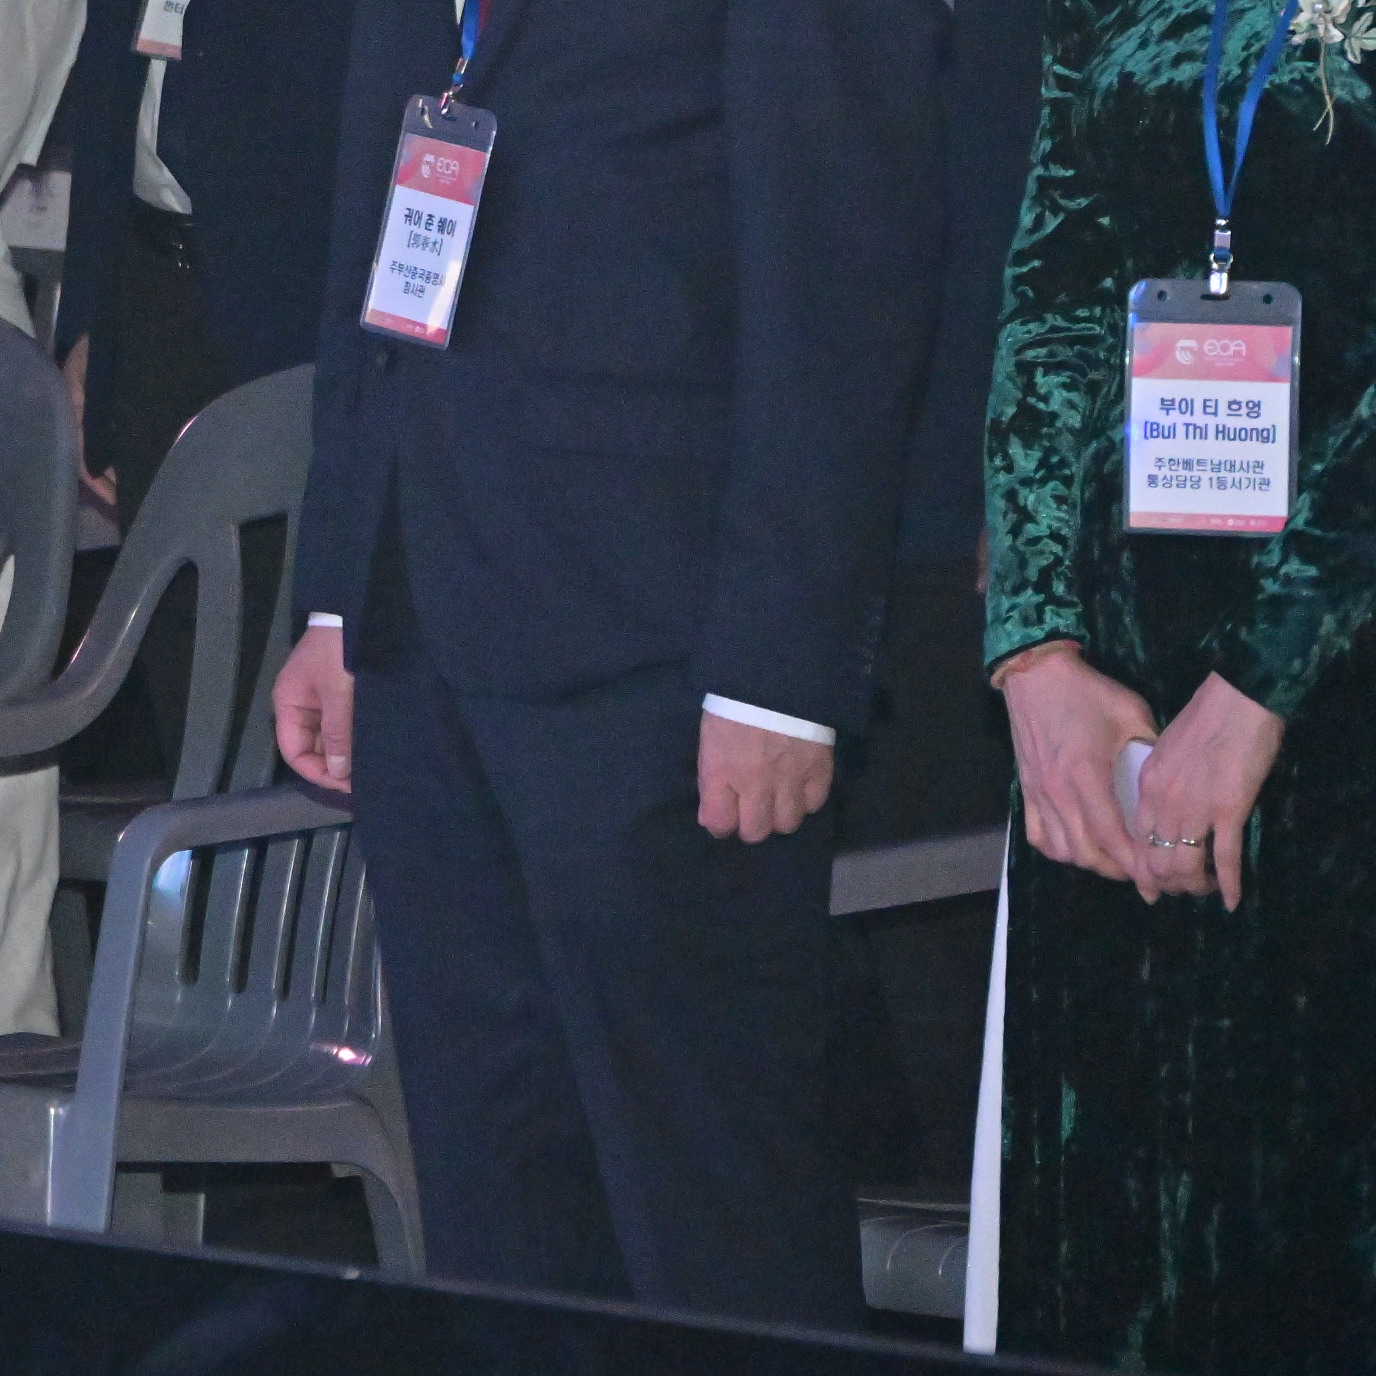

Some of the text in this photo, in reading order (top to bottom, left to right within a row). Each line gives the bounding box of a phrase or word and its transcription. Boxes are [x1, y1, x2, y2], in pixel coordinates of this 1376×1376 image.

[1159, 396, 1262, 419] 부이 티 흐엉
[1182, 422, 1209, 442] Thi
[1153, 456, 1265, 475] 주한베트남대사관
[1207, 475, 1271, 492] 1등서기관
